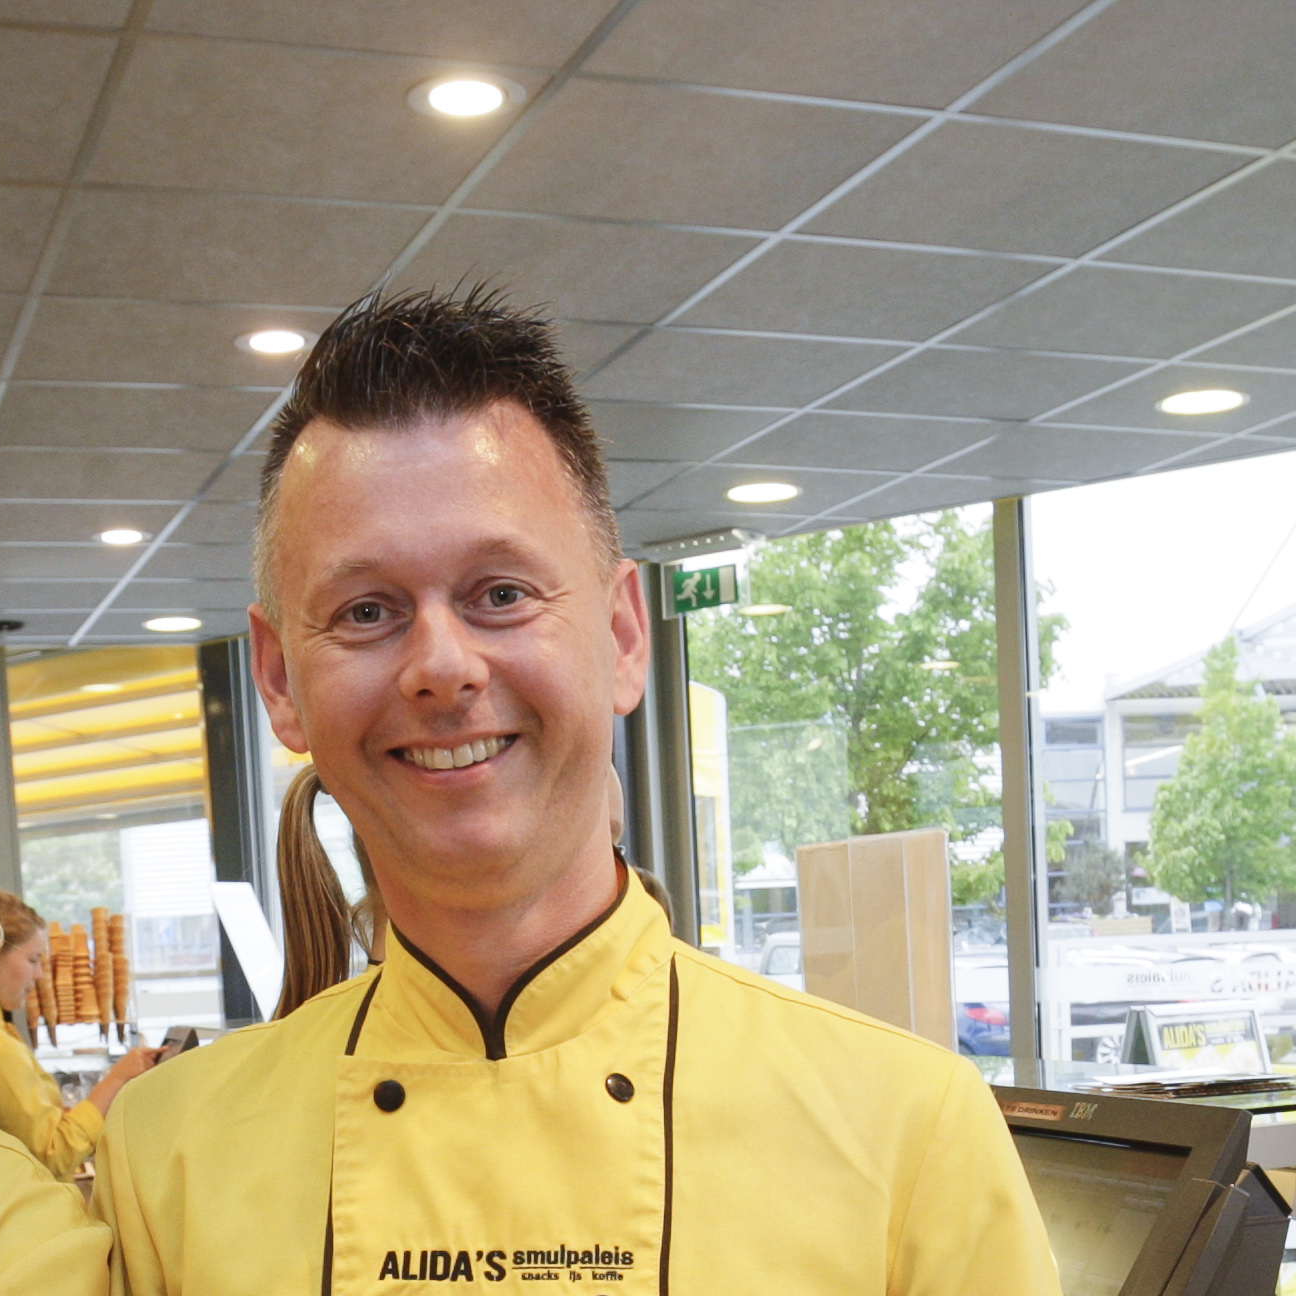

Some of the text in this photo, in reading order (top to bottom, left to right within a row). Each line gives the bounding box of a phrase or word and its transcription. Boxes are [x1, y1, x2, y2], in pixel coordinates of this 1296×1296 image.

[1163, 1023, 1206, 1048] ALIDA'S
[1017, 1106, 1058, 1116] DRINKEN
[1069, 1101, 1098, 1120] IBM
[378, 1244, 634, 1282] ALIDA'S smulpaleis
[521, 1270, 560, 1281] snacks
